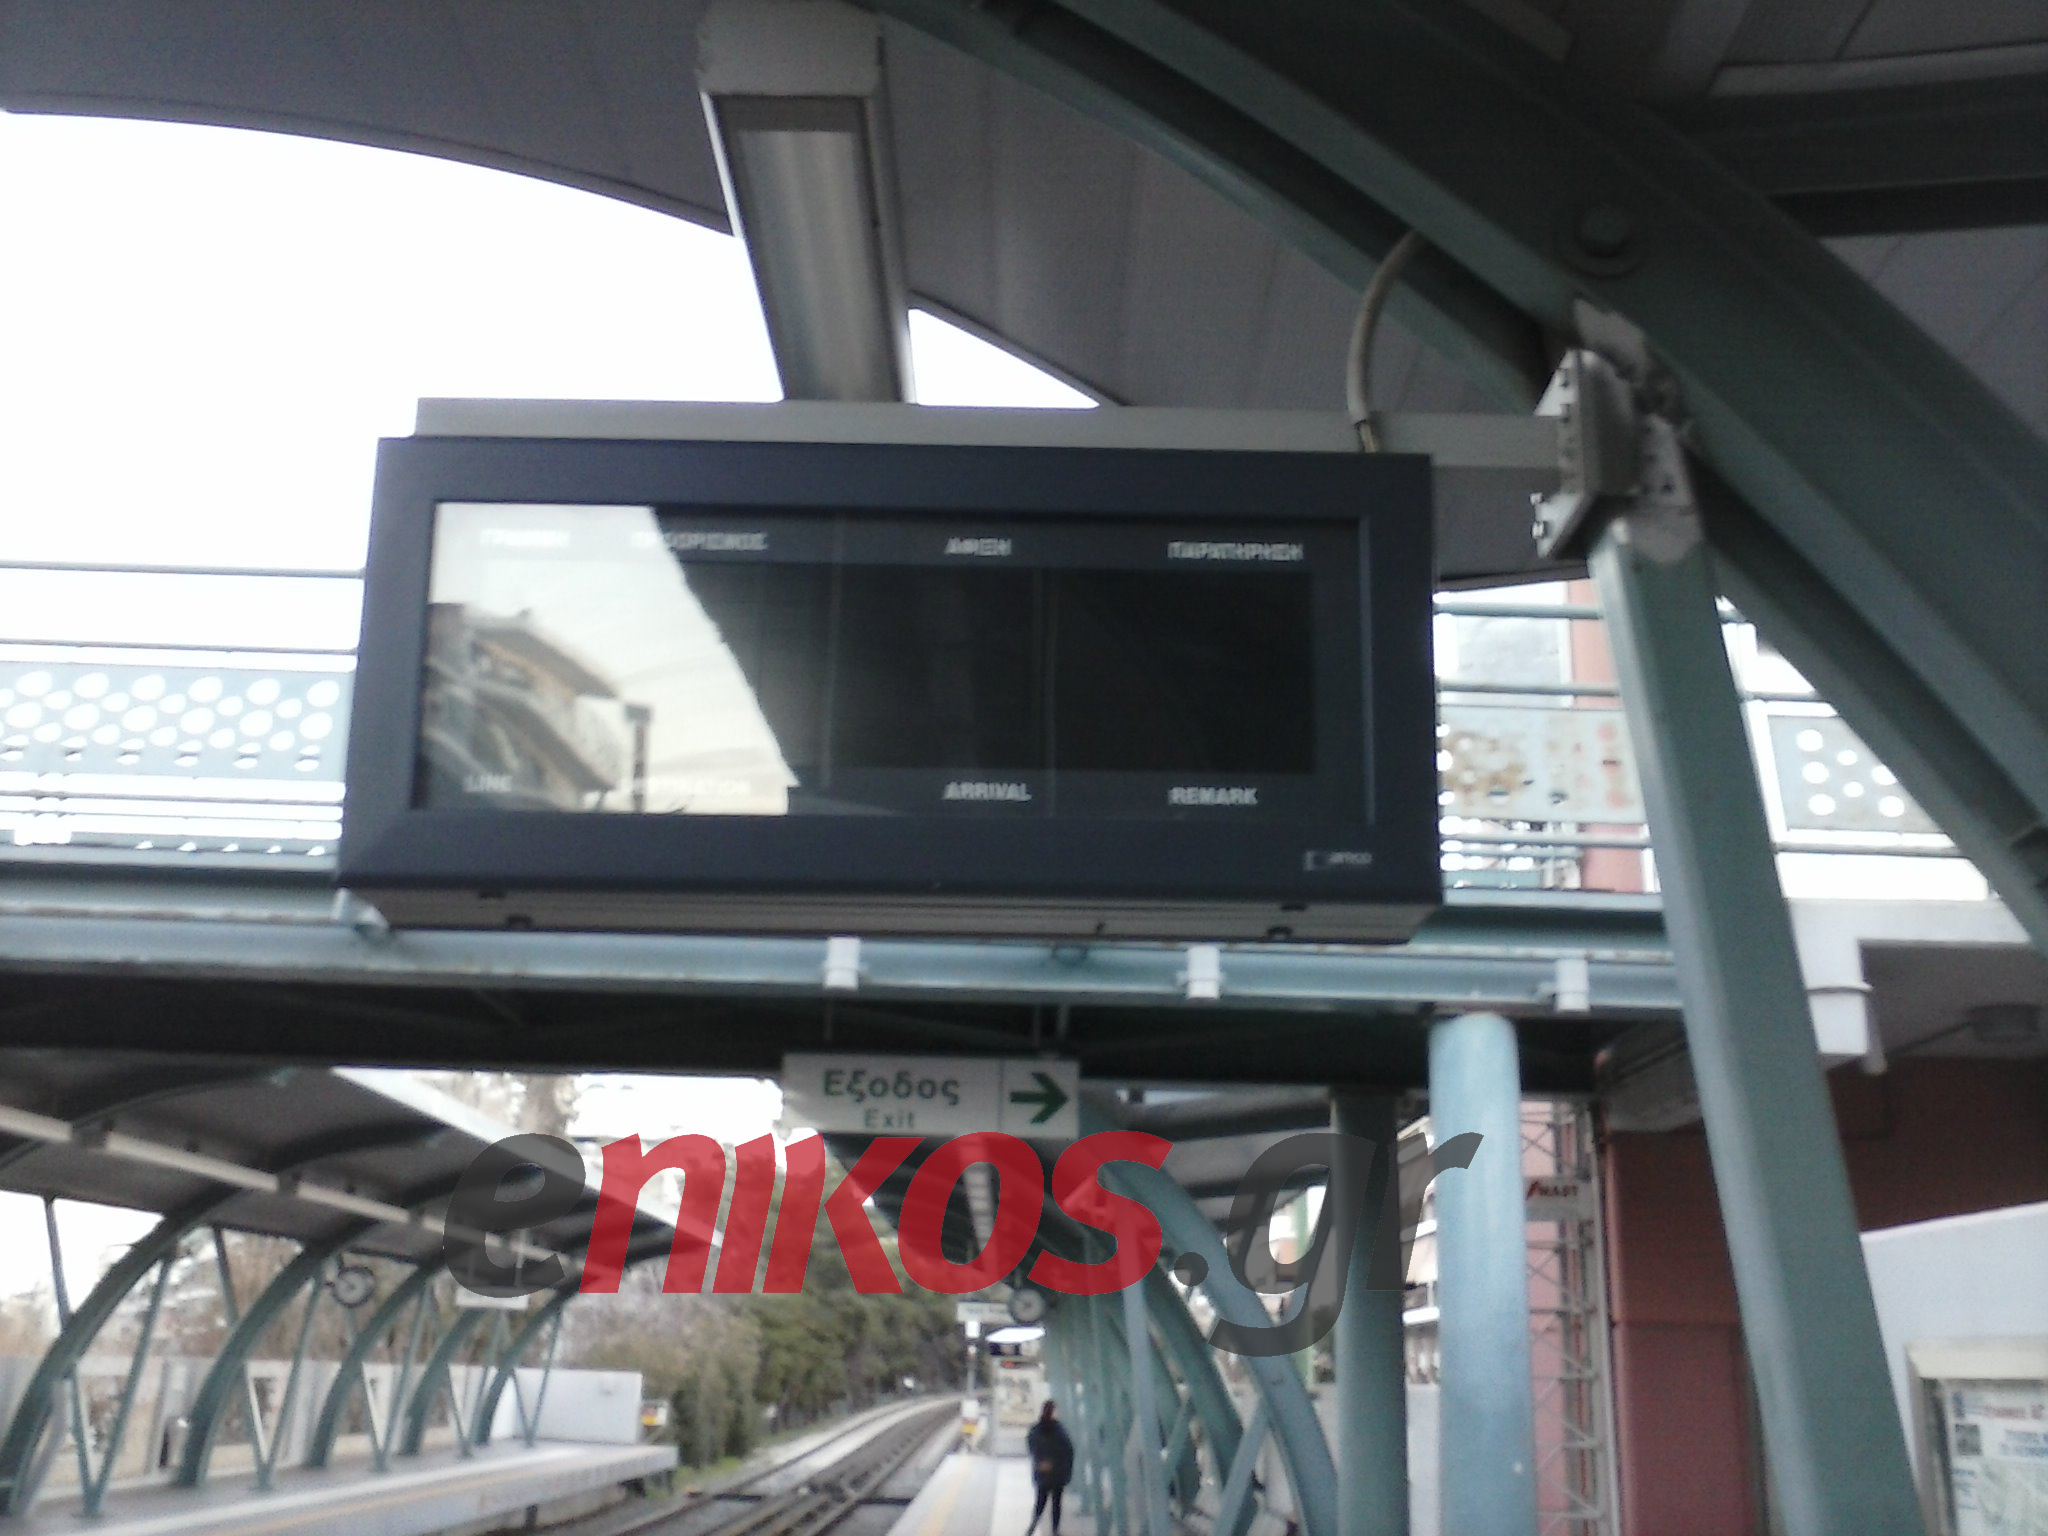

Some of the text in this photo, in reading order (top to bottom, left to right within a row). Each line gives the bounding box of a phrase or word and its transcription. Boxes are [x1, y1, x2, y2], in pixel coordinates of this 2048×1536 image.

[941, 781, 1033, 801] ARRIVAL
[1167, 786, 1259, 806] REMARK
[822, 1068, 961, 1106] Εξοδος
[865, 1108, 916, 1131] Exit
